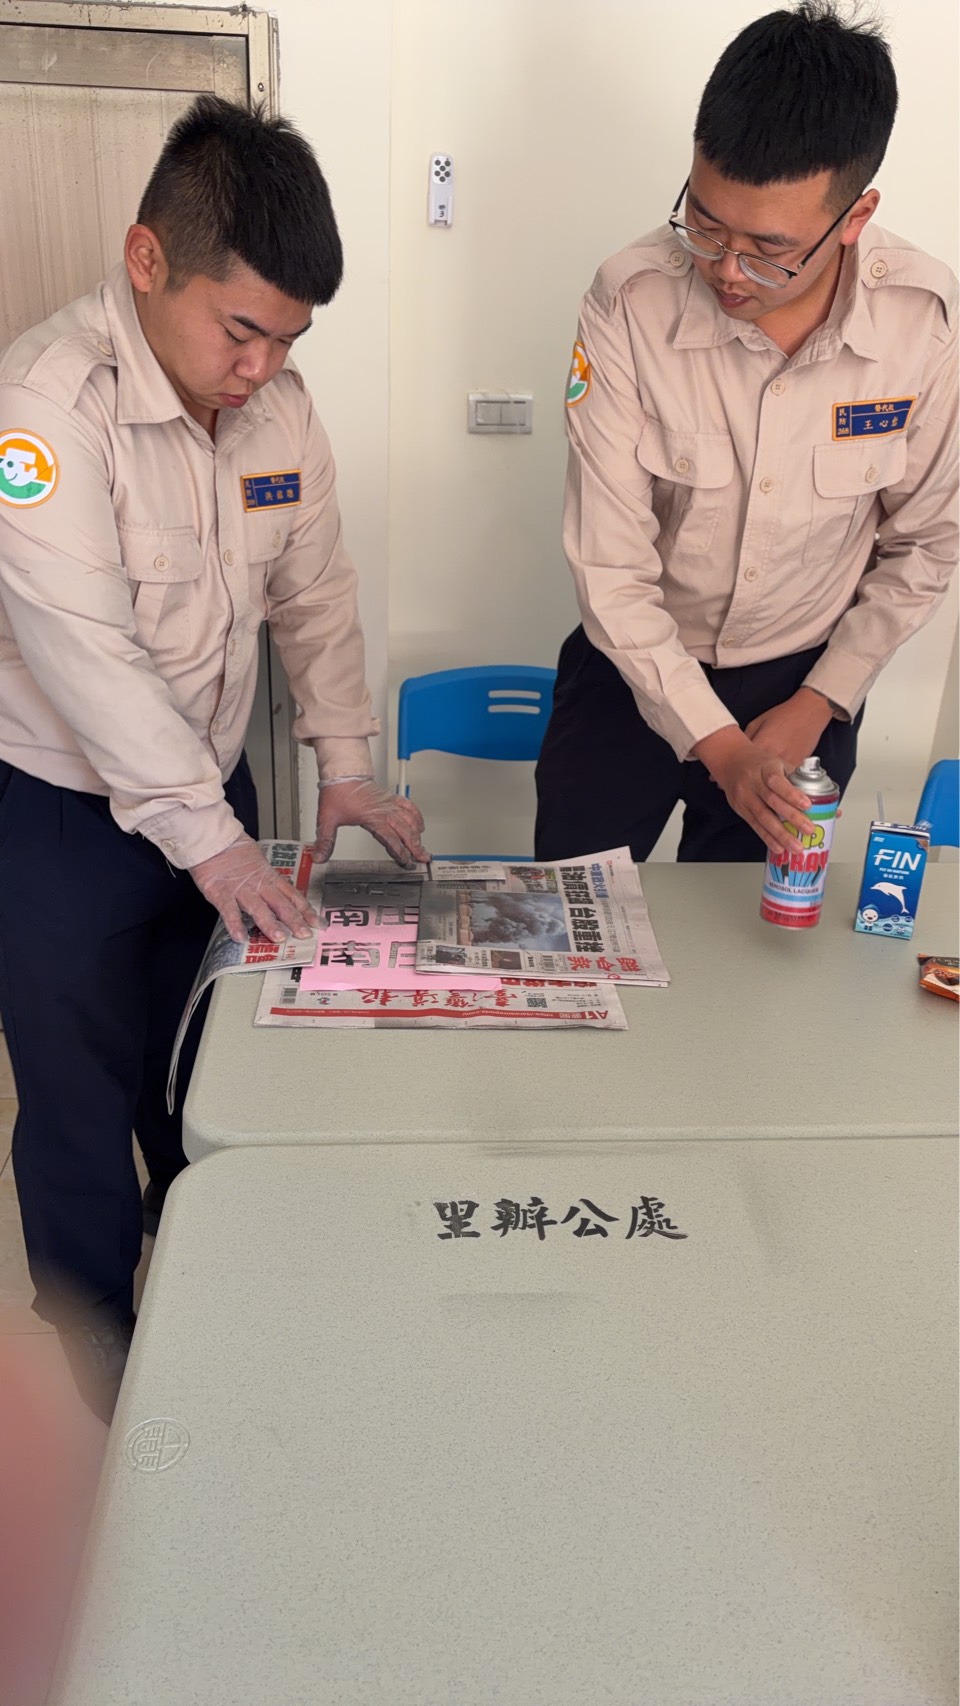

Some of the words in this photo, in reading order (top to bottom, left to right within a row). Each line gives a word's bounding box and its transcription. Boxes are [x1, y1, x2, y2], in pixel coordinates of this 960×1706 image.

[872, 848, 922, 871] FIN
[768, 881, 792, 893] AEROSOL
[567, 955, 641, 973] 聯合報
[433, 1194, 689, 1241] 里辦公處
